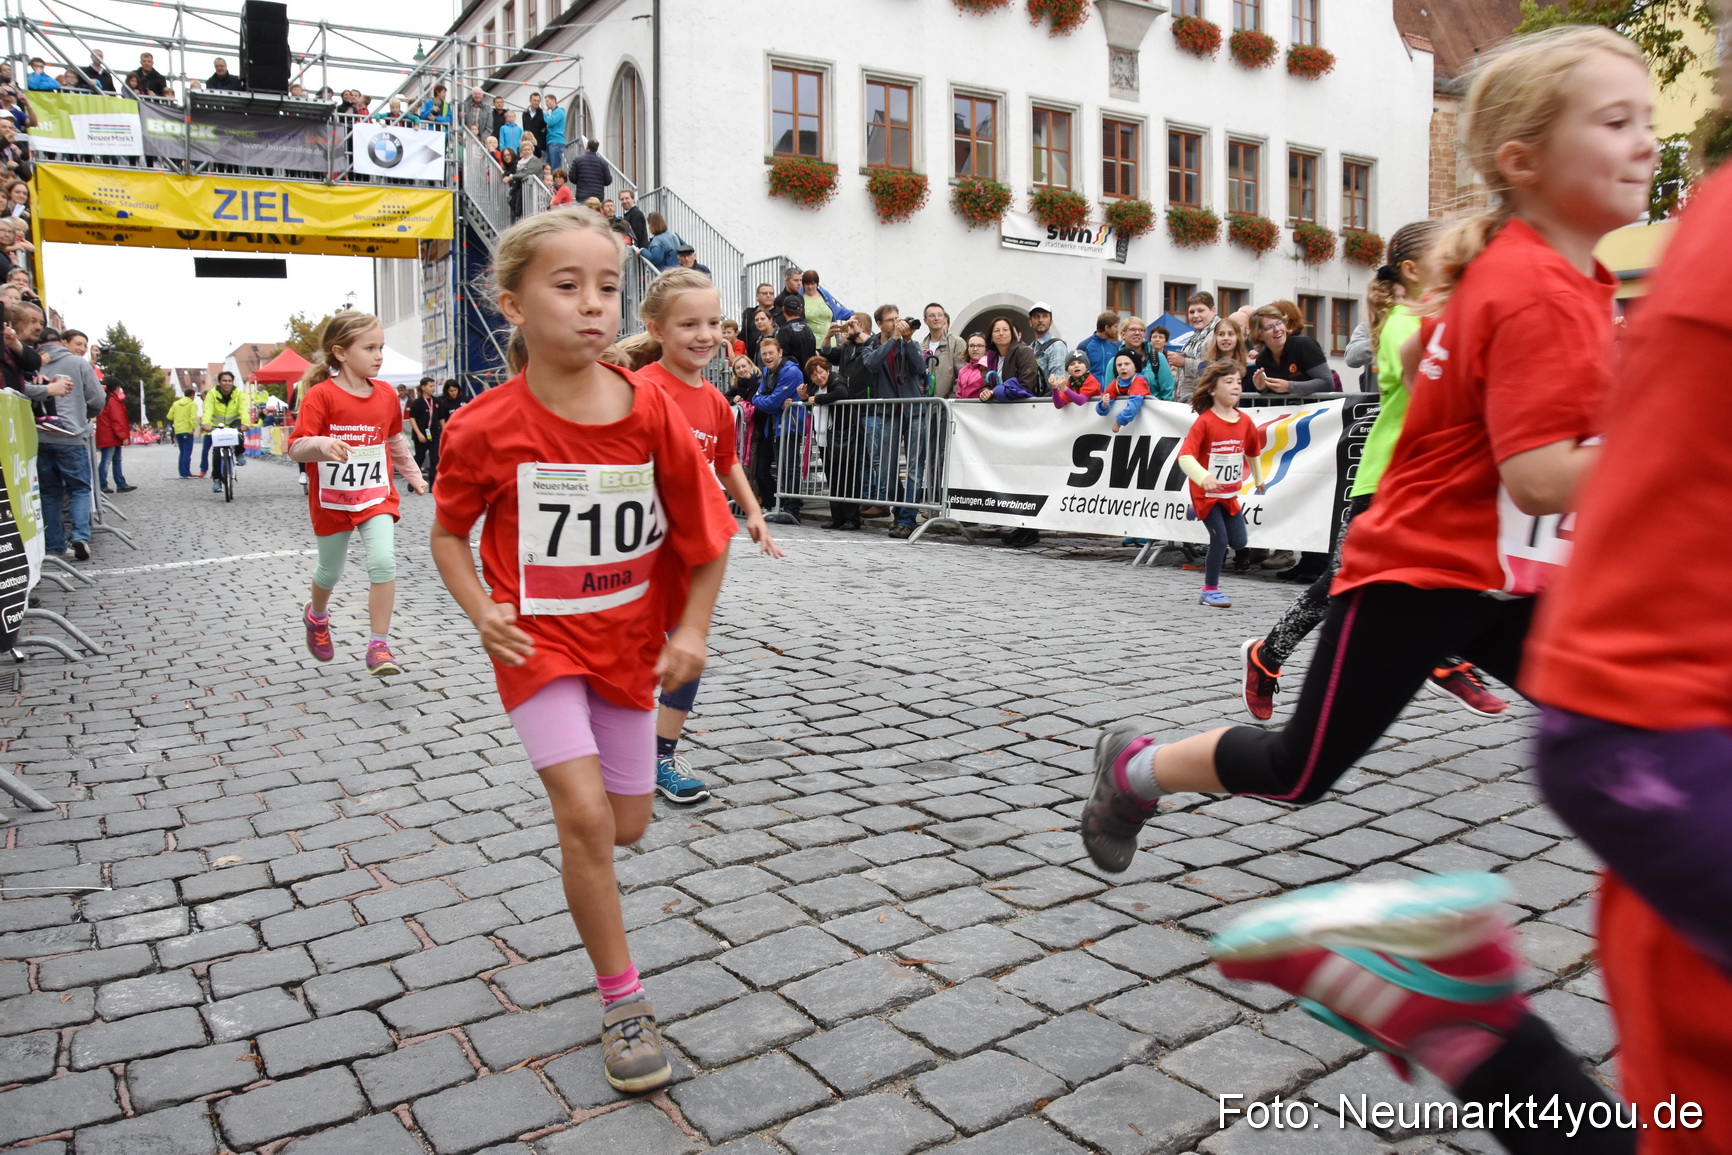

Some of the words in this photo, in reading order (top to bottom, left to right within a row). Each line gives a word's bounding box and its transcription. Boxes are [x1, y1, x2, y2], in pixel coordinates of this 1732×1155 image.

[87, 133, 134, 143] NeuerMarkt
[63, 194, 116, 207] Neumarkter
[119, 199, 159, 210] Stadtlauf
[213, 188, 304, 223] ZIEL
[353, 214, 398, 222] Neumarkter
[400, 215, 434, 223] Stadtlauf
[1047, 224, 1092, 243] swn
[329, 423, 375, 432] Neumarkter
[329, 433, 366, 442] Stadtlauf
[326, 461, 381, 486] 7474
[533, 481, 589, 491] NeuerMarkt
[984, 497, 996, 507] die
[997, 499, 1037, 511] verbinden
[1059, 493, 1159, 519] stadtwerke
[527, 553, 534, 563] 3
[582, 570, 632, 593] Anna
